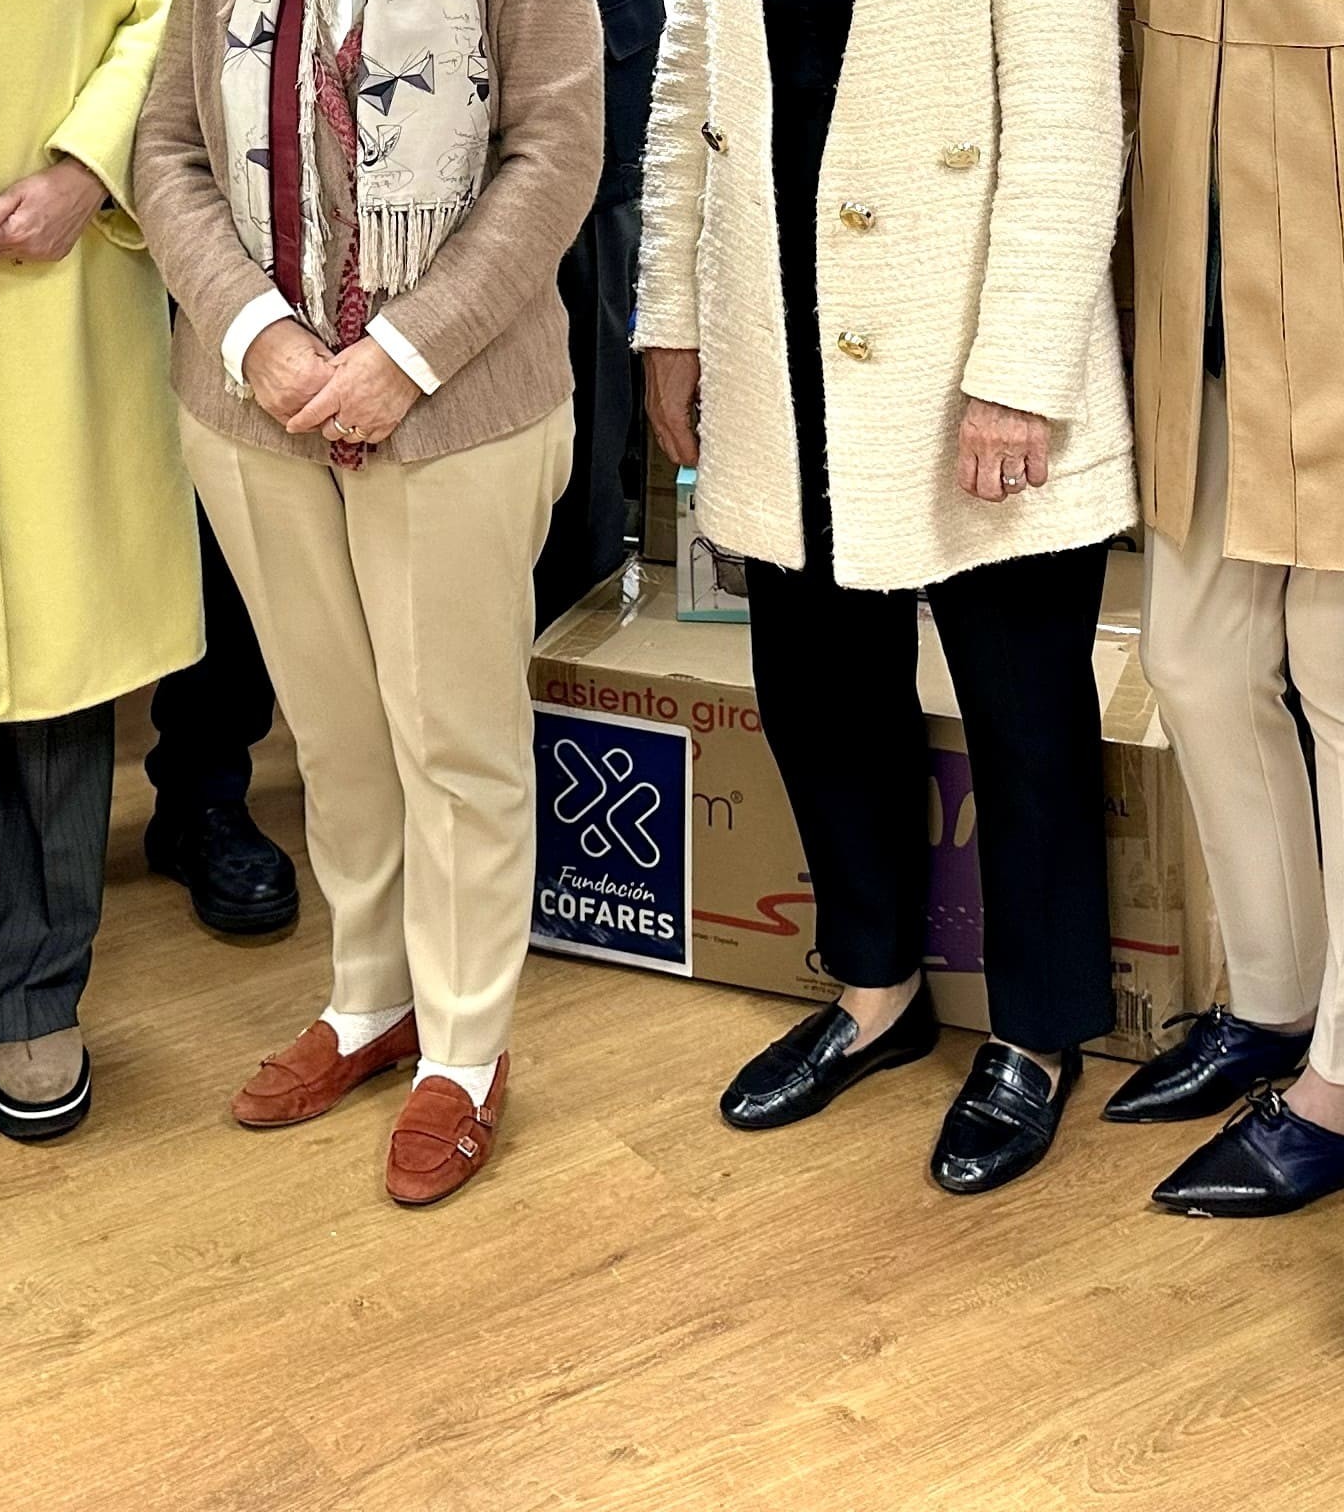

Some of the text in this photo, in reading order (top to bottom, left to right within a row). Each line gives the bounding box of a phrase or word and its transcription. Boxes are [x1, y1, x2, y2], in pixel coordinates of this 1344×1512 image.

[547, 679, 678, 719] asiento
[558, 865, 655, 903] Fundación
[540, 888, 675, 939] COFARES
